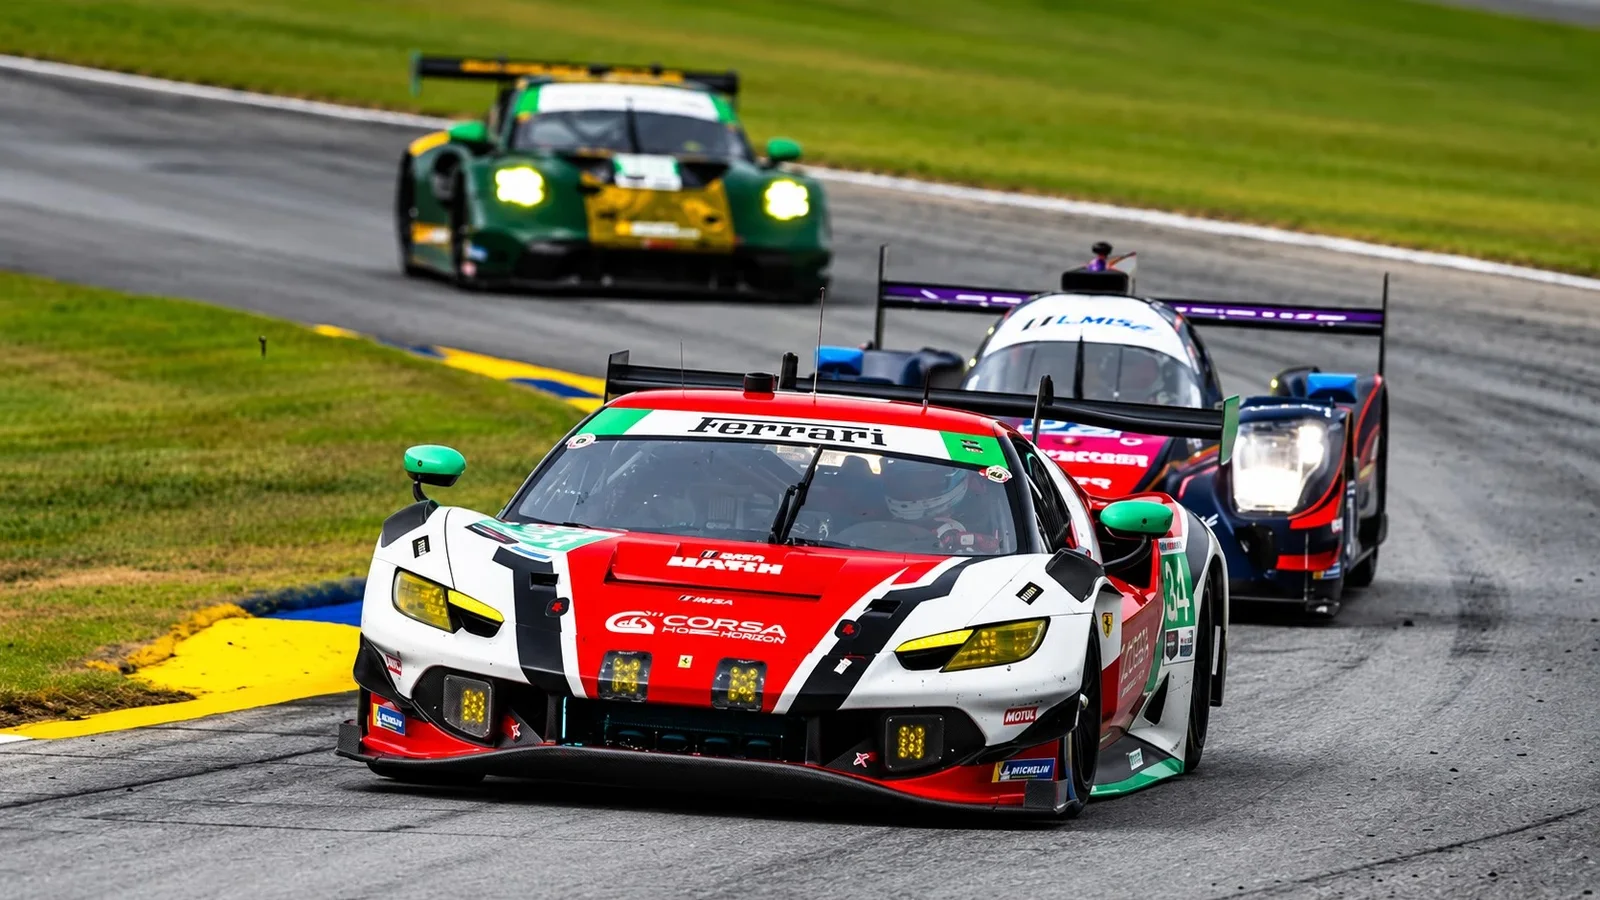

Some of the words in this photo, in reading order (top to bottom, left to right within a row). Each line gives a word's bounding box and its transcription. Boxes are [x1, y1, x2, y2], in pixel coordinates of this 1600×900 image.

[687, 416, 887, 446] Ferrari
[1165, 557, 1189, 622] 34
[662, 614, 787, 637] CORSA
[720, 630, 786, 644] HORIZON
[1005, 709, 1035, 722] MOTUL
[1011, 765, 1050, 775] MICHELIN
